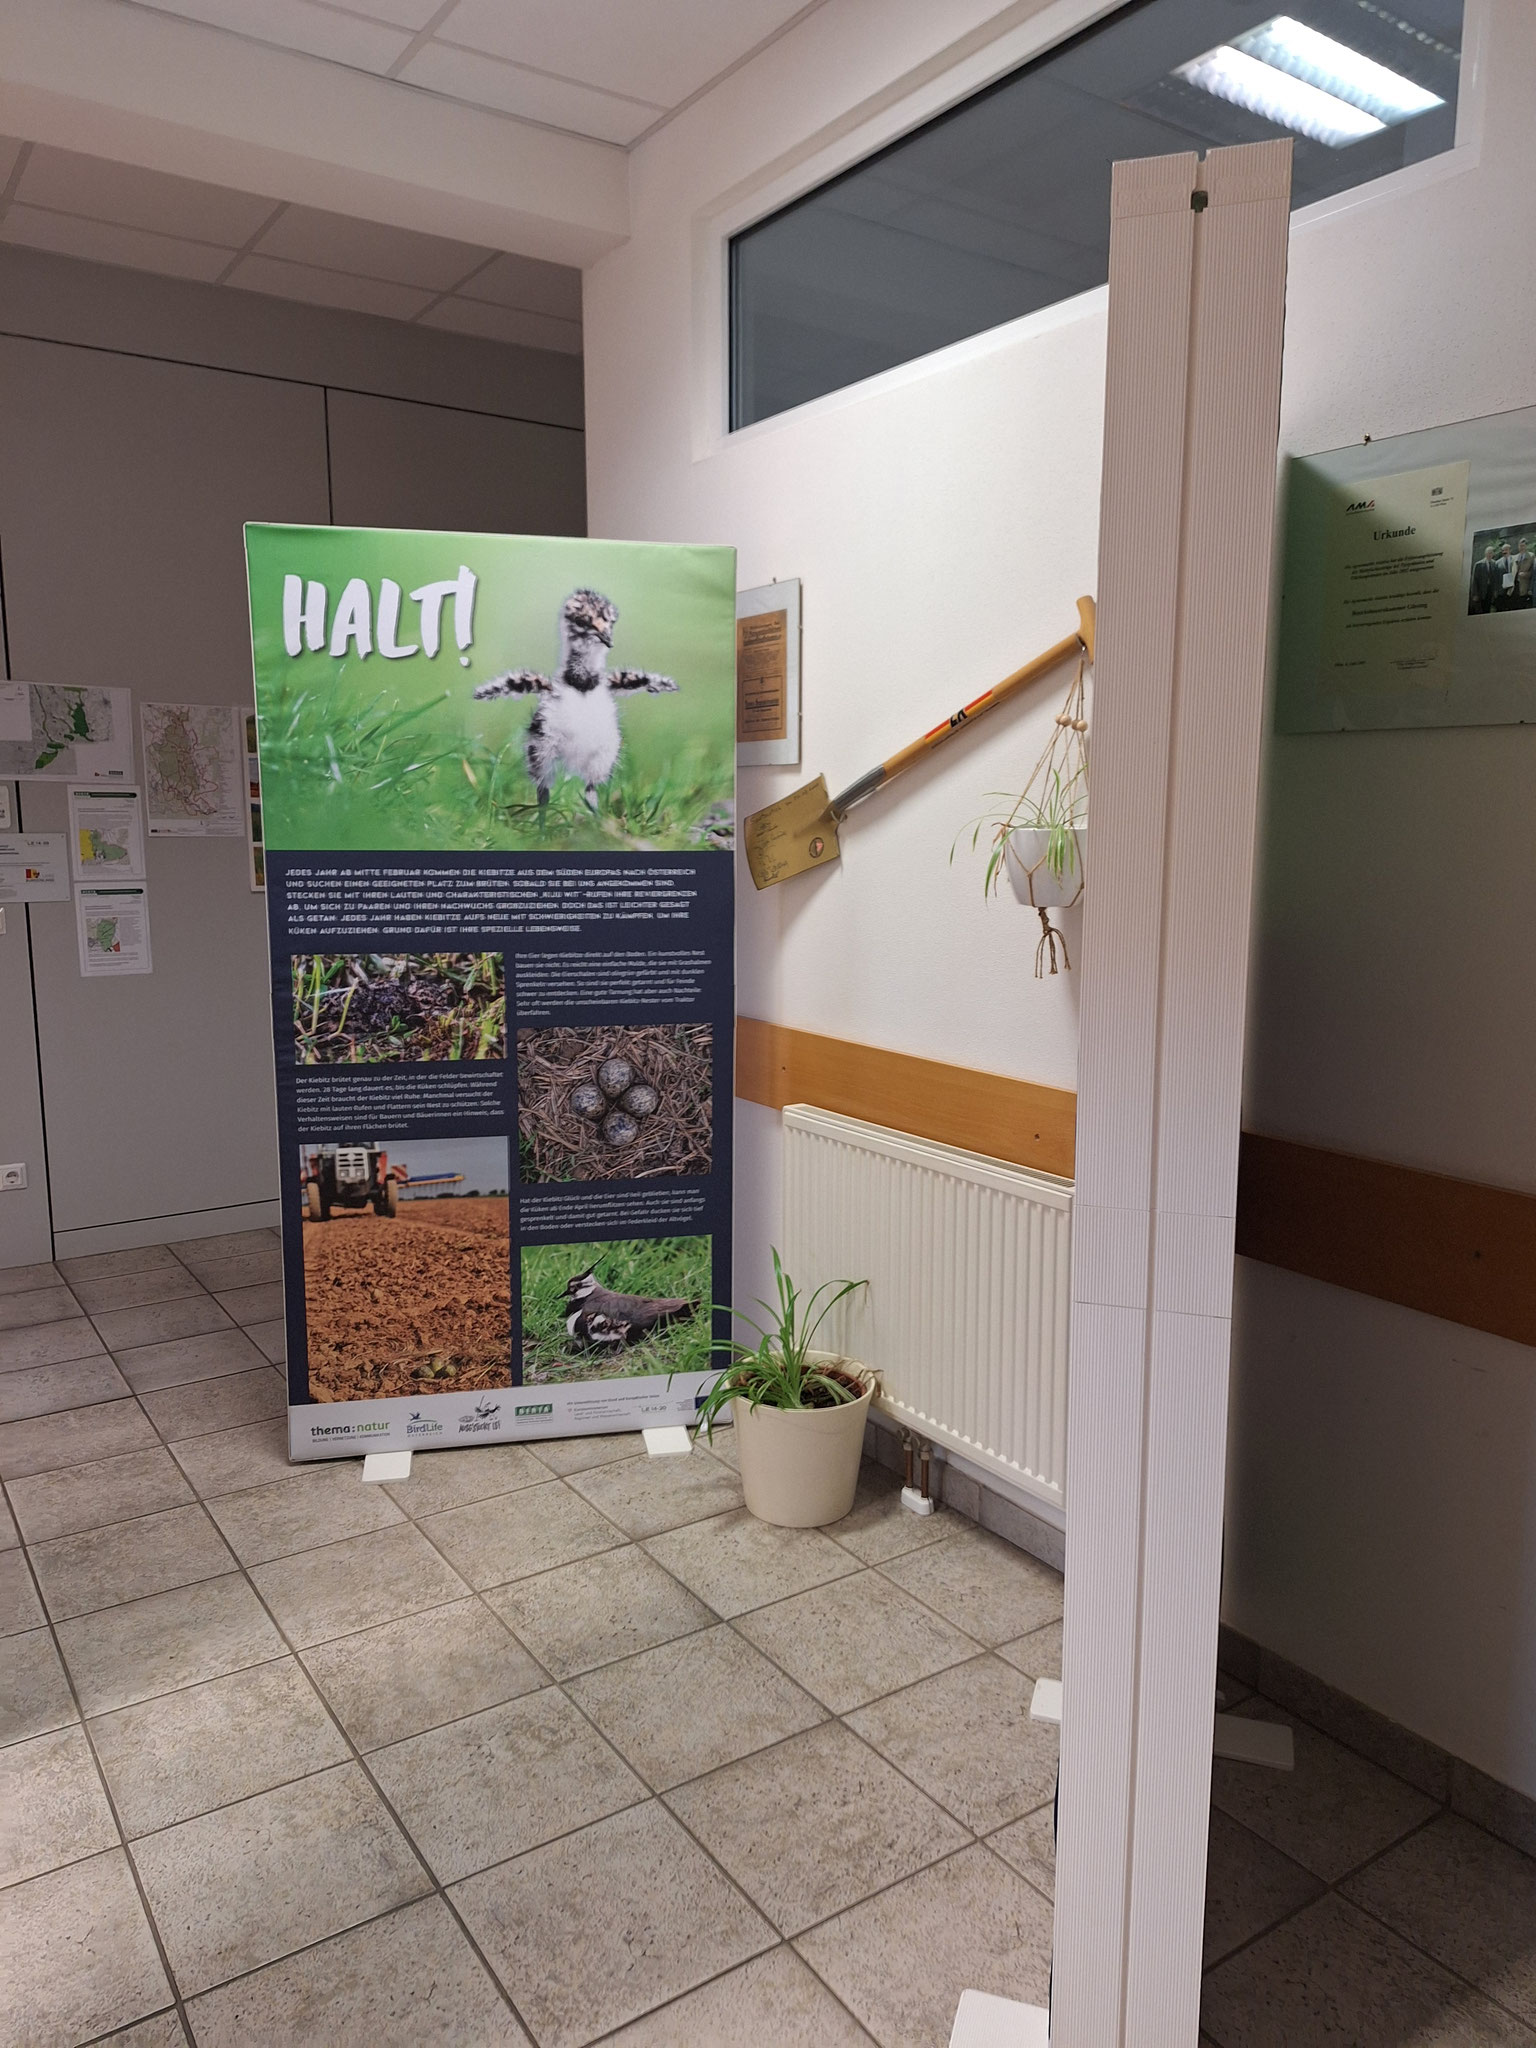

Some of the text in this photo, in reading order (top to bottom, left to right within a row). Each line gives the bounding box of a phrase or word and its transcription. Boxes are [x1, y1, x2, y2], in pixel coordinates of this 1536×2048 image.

[1373, 526, 1416, 541] Urkunde
[283, 565, 478, 667] HALT!
[288, 925, 316, 934] KÜKEN
[414, 924, 441, 933] DAFÜR
[310, 1422, 390, 1436] thema:natur
[406, 1423, 443, 1434] BirdLife
